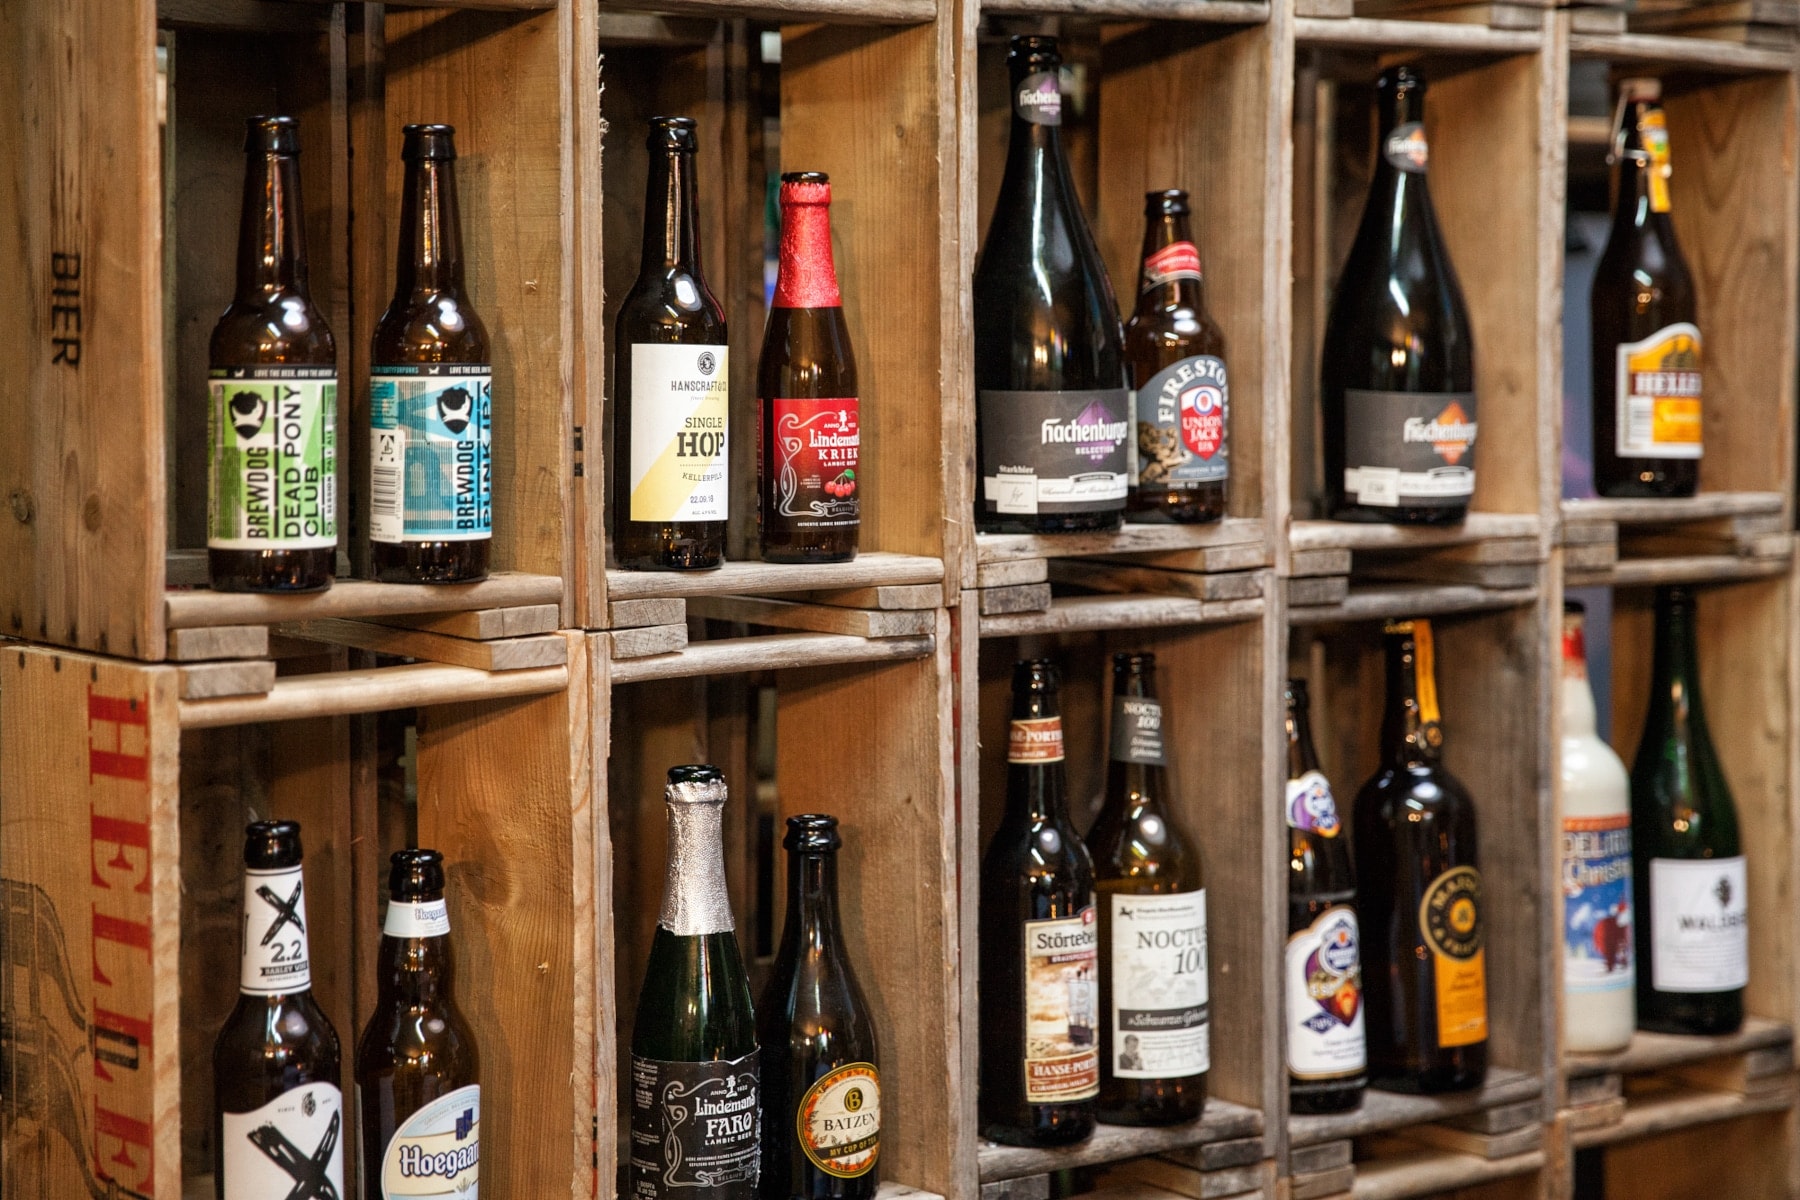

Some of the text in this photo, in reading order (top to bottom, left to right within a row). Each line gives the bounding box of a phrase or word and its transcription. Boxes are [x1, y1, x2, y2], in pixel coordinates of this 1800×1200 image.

[52, 253, 81, 370] BIER
[685, 417, 723, 429] SINGLE
[676, 432, 725, 457] HOP
[1190, 428, 1219, 443] JACK
[283, 385, 301, 538] DEAD PONY
[998, 465, 1035, 474] Starkbier
[456, 440, 475, 529] BREWDOG
[682, 472, 723, 482] KELLERPILS
[247, 447, 269, 538] BREWDOG
[304, 466, 319, 537] CLUB
[270, 940, 302, 963] 2.2
[705, 1112, 753, 1138] FARO
[824, 1111, 876, 1132] BATZEN
[704, 1131, 752, 1146] LAMBIC BEER
[829, 1148, 841, 1157] MY
[843, 1144, 857, 1154] CUP
[858, 1141, 867, 1150] OF
